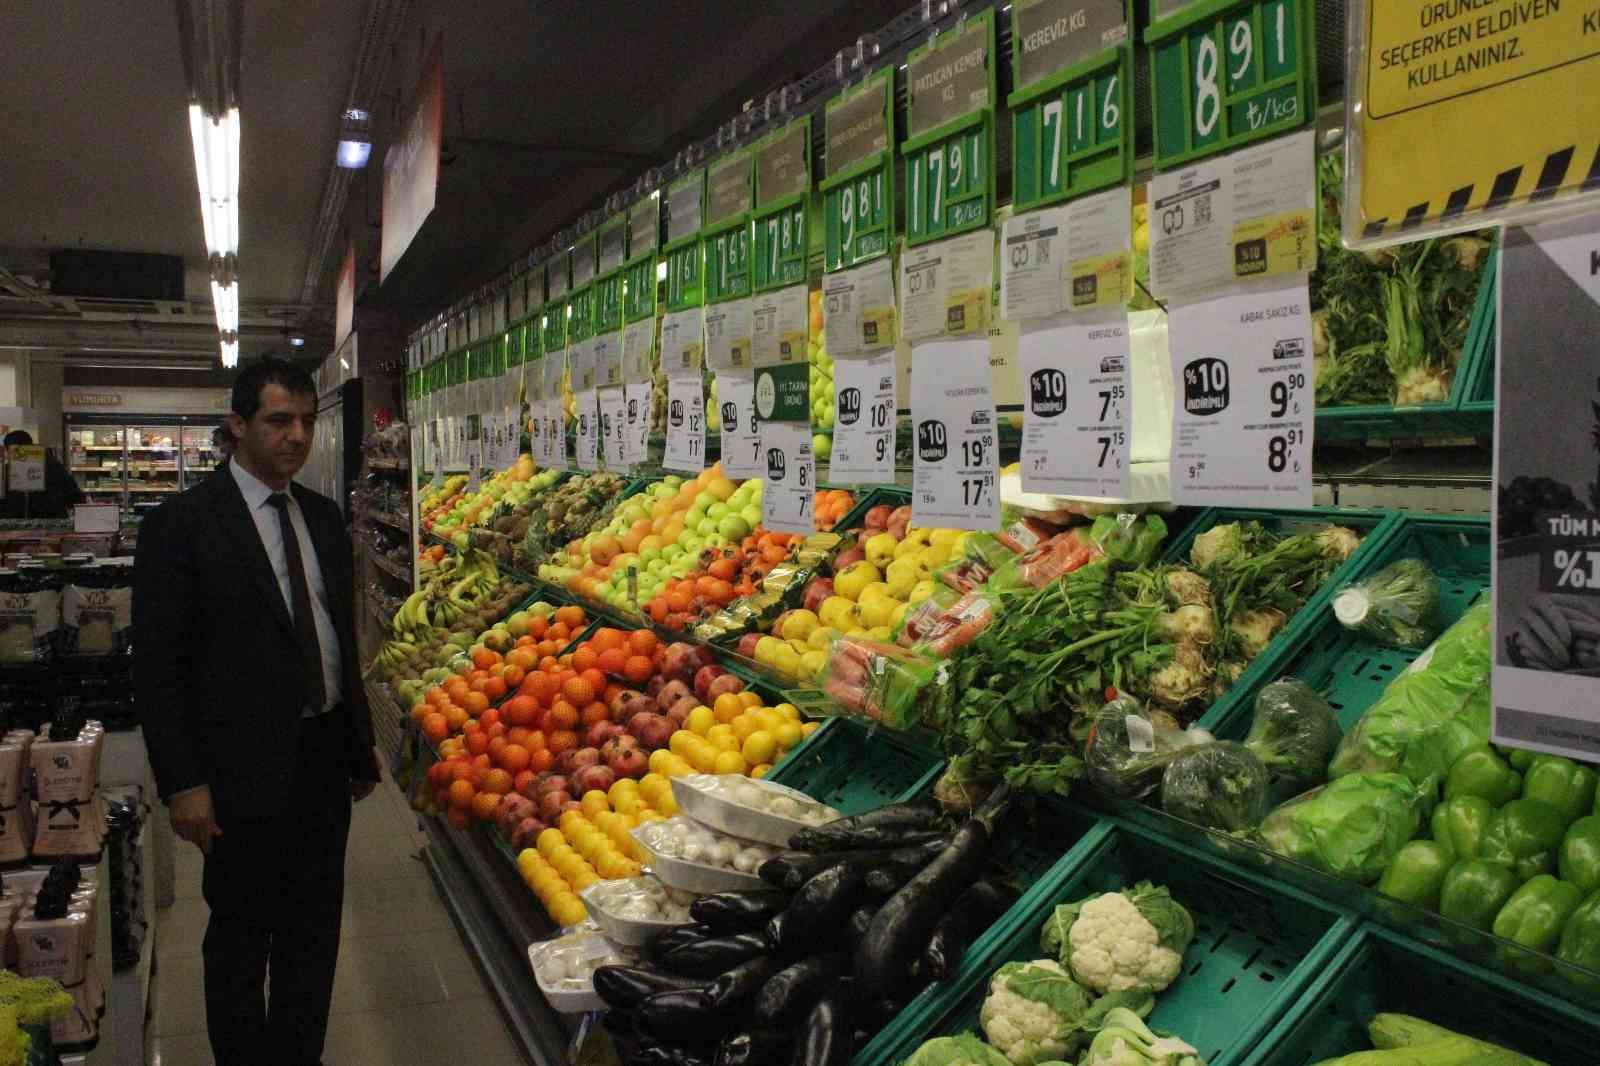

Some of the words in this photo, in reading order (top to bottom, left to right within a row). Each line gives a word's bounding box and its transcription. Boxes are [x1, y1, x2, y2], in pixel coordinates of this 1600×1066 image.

[1069, 9, 1087, 32] KG
[1380, 23, 1472, 70] SEÇERKEN
[1476, 0, 1560, 39] ELDİVEN
[1407, 37, 1524, 90] KULLANINIZ.
[1032, 371, 1065, 398] %10
[1185, 361, 1227, 393] %10
[920, 423, 945, 445] %10
[1548, 514, 1588, 537] TÜM
